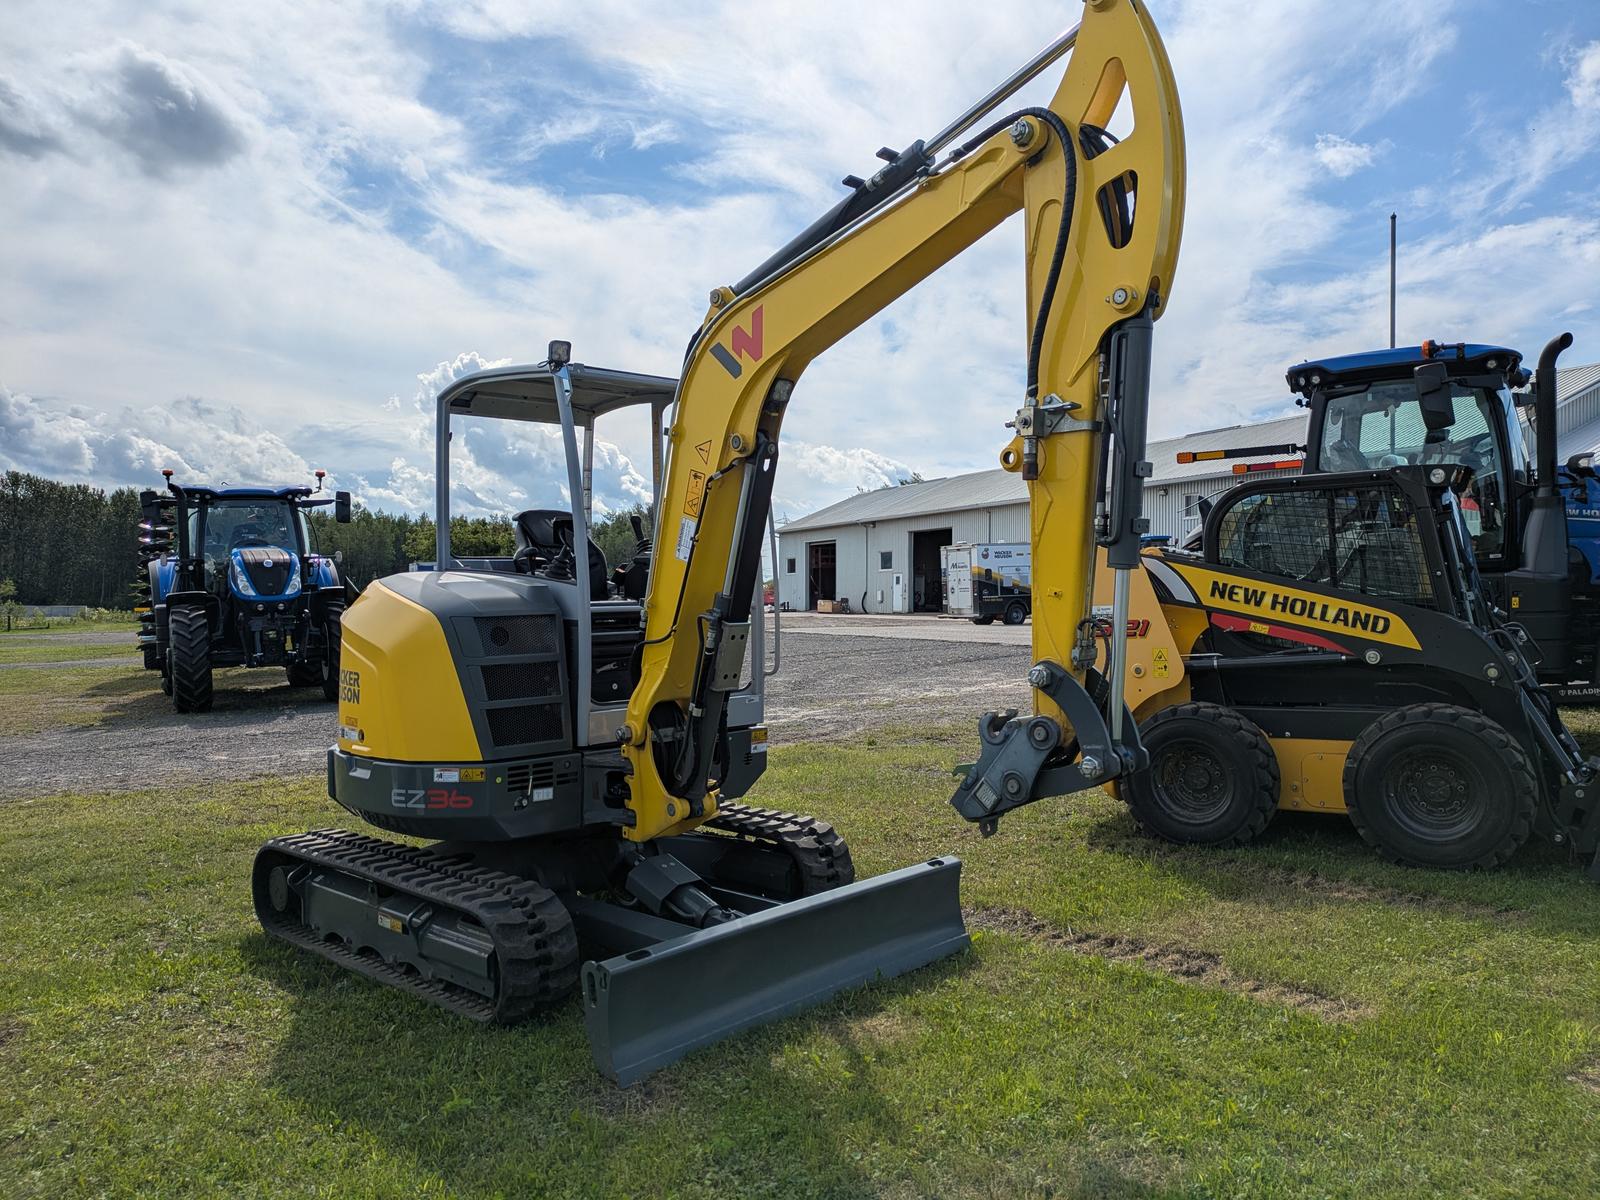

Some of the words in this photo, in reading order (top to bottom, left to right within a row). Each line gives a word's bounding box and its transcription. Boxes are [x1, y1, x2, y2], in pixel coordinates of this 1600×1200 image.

[1209, 580, 1266, 607] NEW
[1270, 593, 1391, 635] HOLLAND
[391, 789, 474, 809] EZ36
